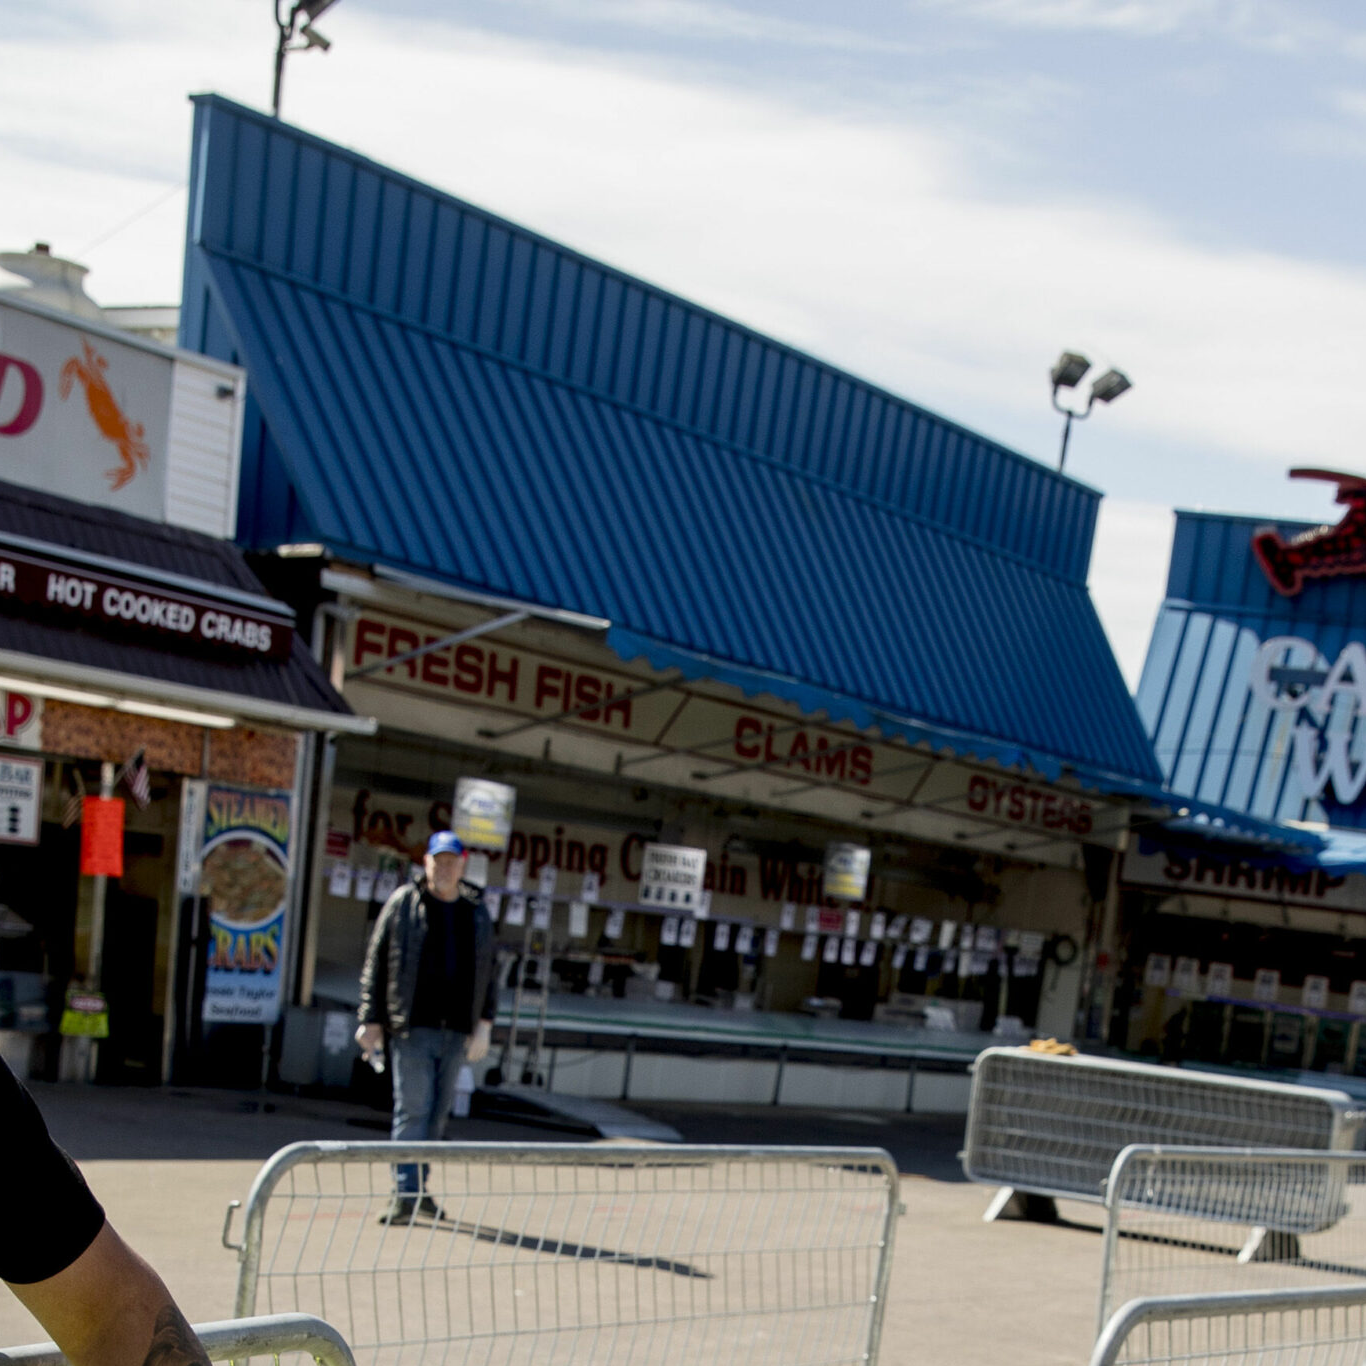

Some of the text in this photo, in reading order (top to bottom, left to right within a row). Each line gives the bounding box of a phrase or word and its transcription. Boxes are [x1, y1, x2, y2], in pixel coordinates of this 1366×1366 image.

[46, 572, 273, 656] HOT COOKED CRABS
[352, 618, 633, 729] FRESH FISH
[735, 716, 874, 786] CLAMS
[352, 788, 413, 842] for
[967, 774, 1094, 835] OYSTERS
[1164, 856, 1344, 898] SHRIMP
